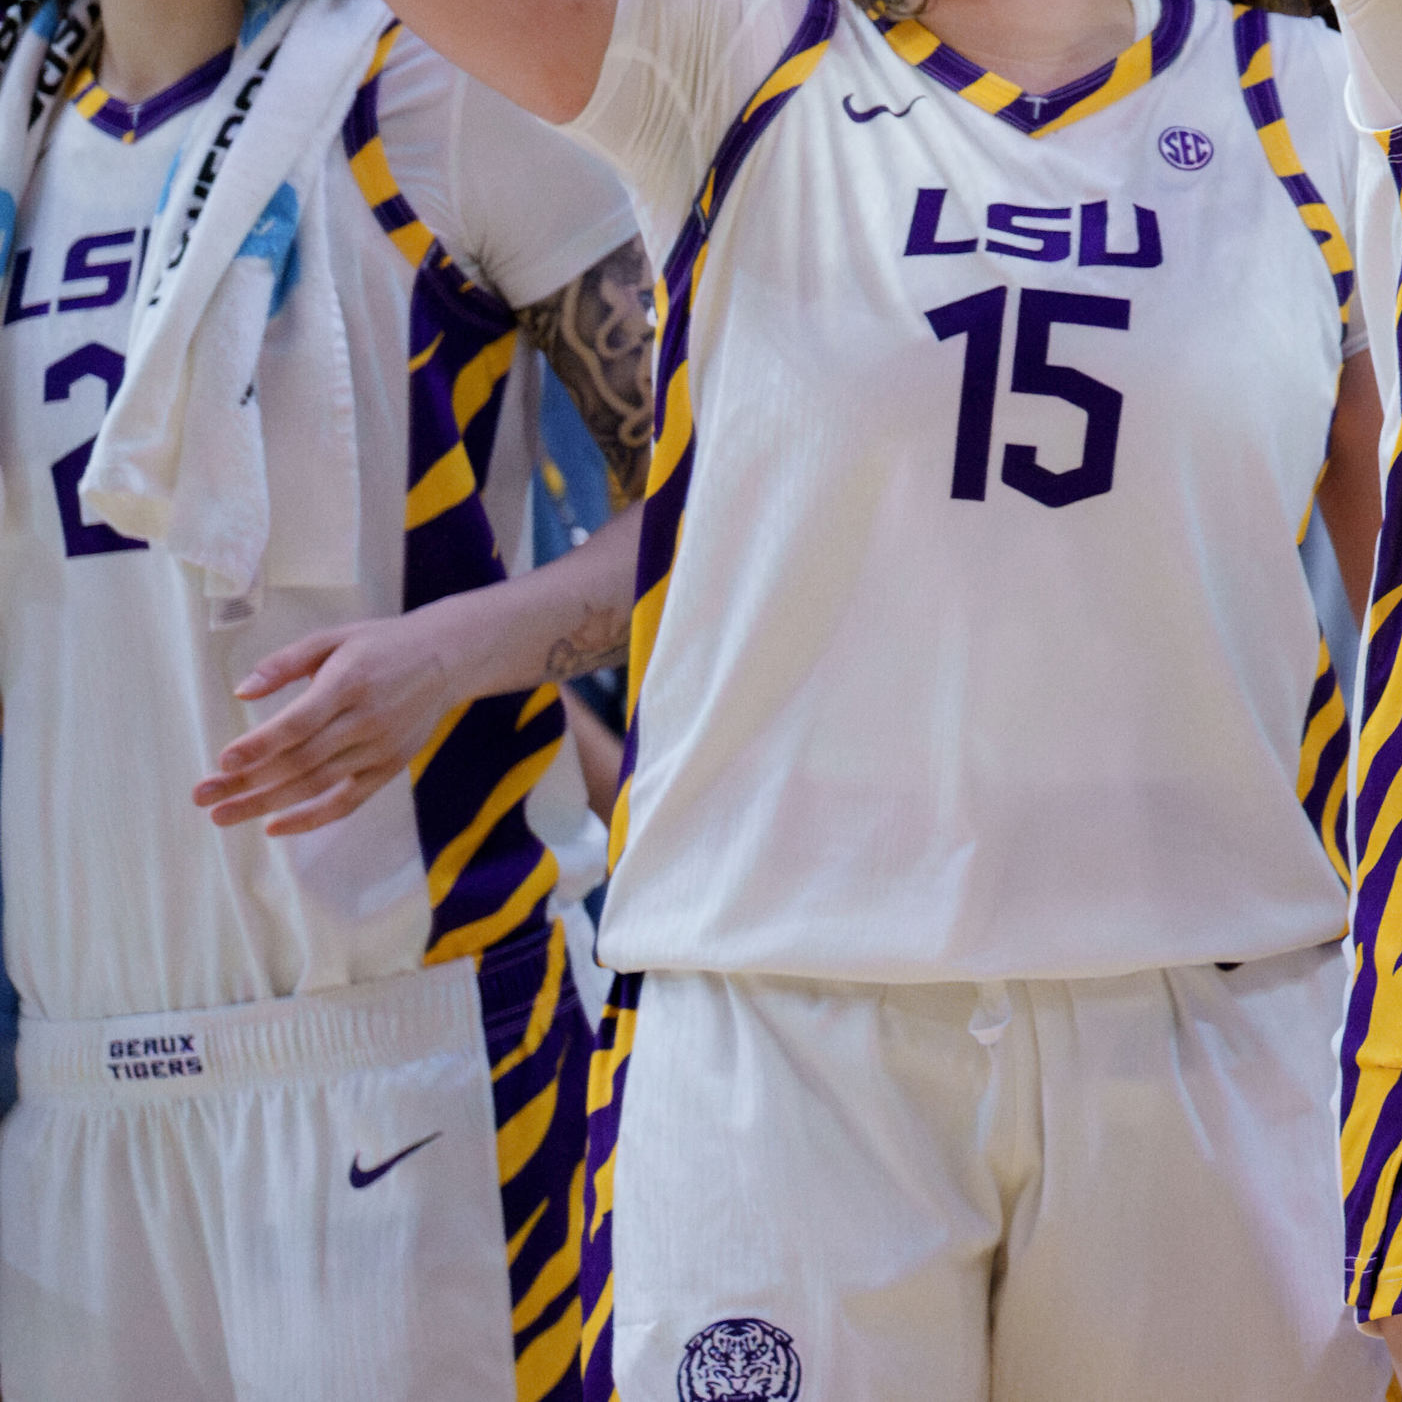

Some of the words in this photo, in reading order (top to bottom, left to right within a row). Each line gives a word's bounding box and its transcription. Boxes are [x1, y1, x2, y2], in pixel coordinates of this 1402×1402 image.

[1164, 131, 1208, 166] SEC
[904, 188, 1163, 269] LSU
[4, 228, 150, 325] LS
[924, 285, 1131, 508] 15
[107, 1057, 203, 1080] TIGERS
